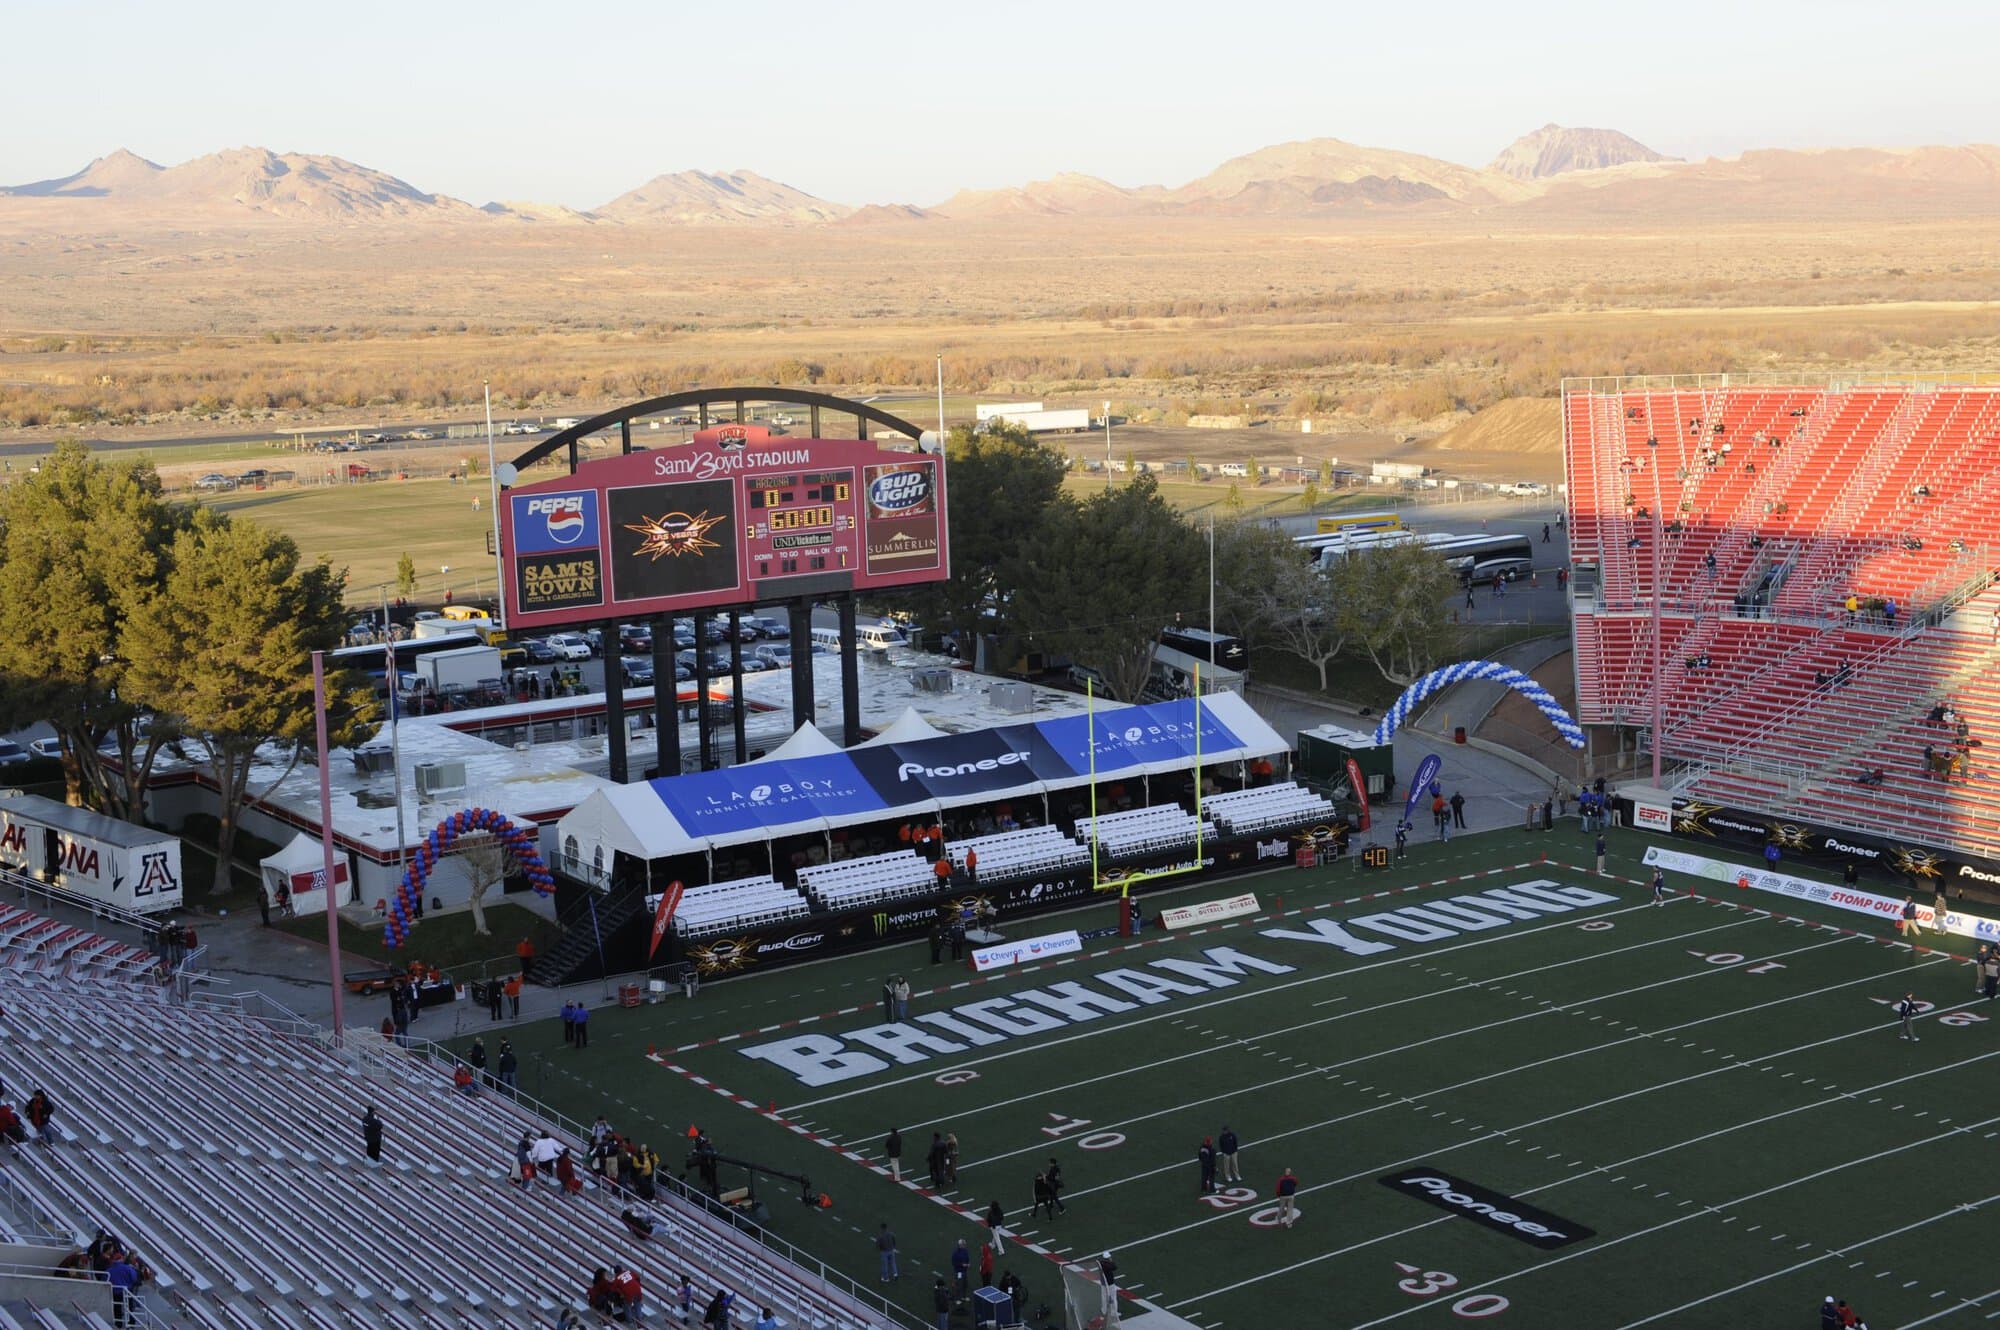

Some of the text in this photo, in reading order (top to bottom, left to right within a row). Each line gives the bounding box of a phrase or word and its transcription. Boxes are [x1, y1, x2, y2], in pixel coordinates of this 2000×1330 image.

[655, 450, 809, 479] Sam Boyd STADIUM
[879, 472, 921, 489] BUD
[765, 489, 779, 507] 0
[836, 484, 849, 501] 0
[874, 483, 926, 503] LIGHT
[528, 496, 583, 515] PEPSI
[770, 507, 832, 530] 60:00
[847, 516, 855, 529] 3
[653, 530, 698, 541] LAS VEGAS
[747, 525, 755, 539] 3
[868, 539, 937, 554] SUMMERLIN
[525, 560, 595, 582] SAM'S
[526, 576, 598, 597] TOWN
[899, 751, 1031, 782] Pioneer
[696, 789, 856, 816] FURNITURE GALLERIES
[1639, 806, 1668, 821] ESPN
[1825, 838, 1880, 858] Pioneer
[1363, 849, 1388, 867] 40
[135, 852, 177, 897] A
[1145, 864, 1168, 875] Desert
[1198, 906, 1224, 915] OUTBACK
[1229, 900, 1256, 909] OUTBACK
[1830, 892, 1873, 908] STOMP
[1874, 901, 1899, 914] OUT
[889, 908, 938, 925] MONSTER
[1165, 913, 1192, 922] OUTBACK
[758, 934, 824, 953] BUD LIGHT
[1042, 937, 1075, 951] Chevron
[990, 948, 1024, 961] Chevron
[737, 879, 1621, 1088] BRIGHAM YOUNG
[935, 1070, 982, 1086] G
[1401, 1177, 1569, 1240] Pioneer
